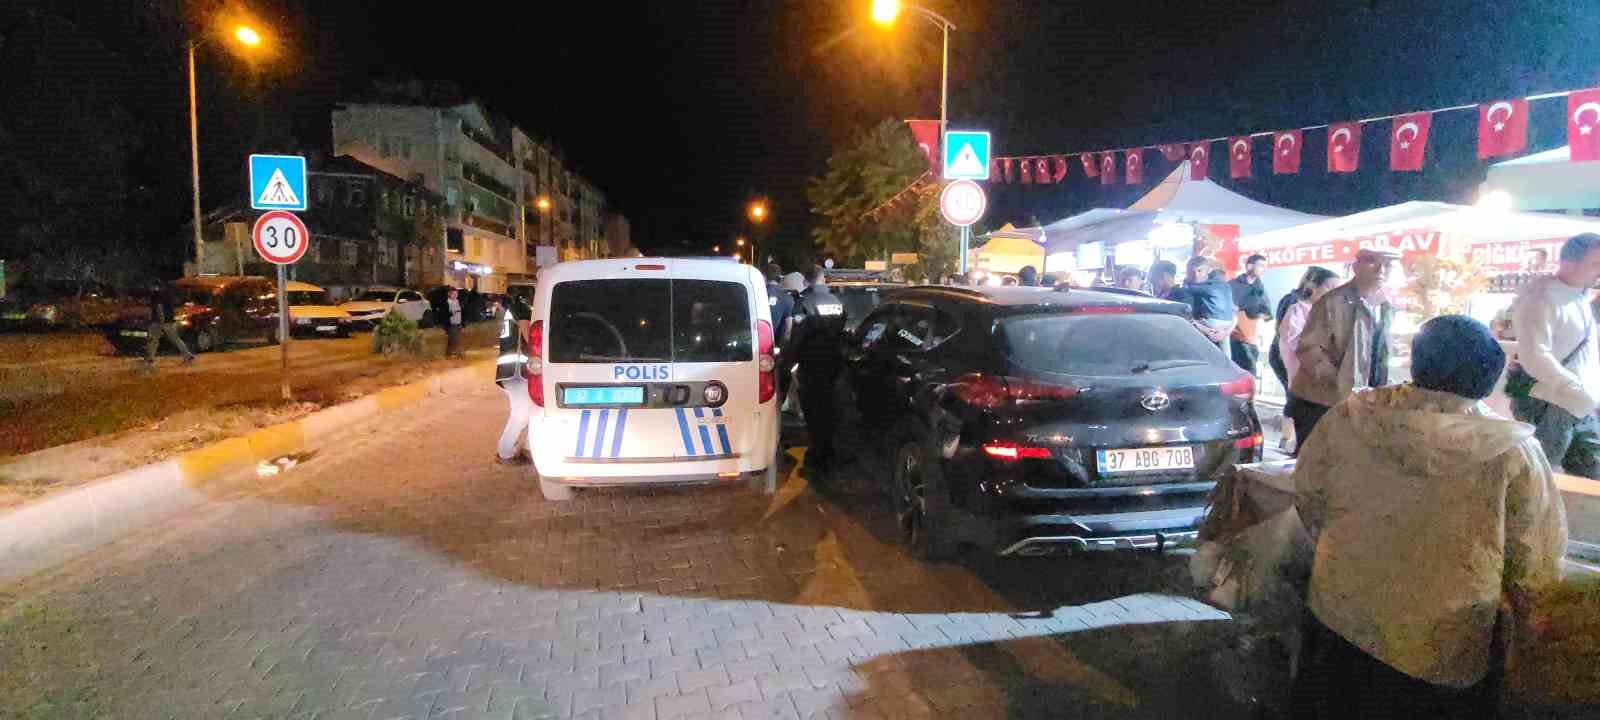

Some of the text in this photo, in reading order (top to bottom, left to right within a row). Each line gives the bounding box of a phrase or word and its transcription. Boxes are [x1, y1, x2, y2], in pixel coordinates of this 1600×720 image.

[266, 225, 296, 248] 30
[1238, 244, 1335, 270] KÖFTE
[614, 365, 669, 380] POLİS
[1109, 452, 1125, 469] 37
[1135, 450, 1160, 468] ABG
[1166, 449, 1191, 466] 708
